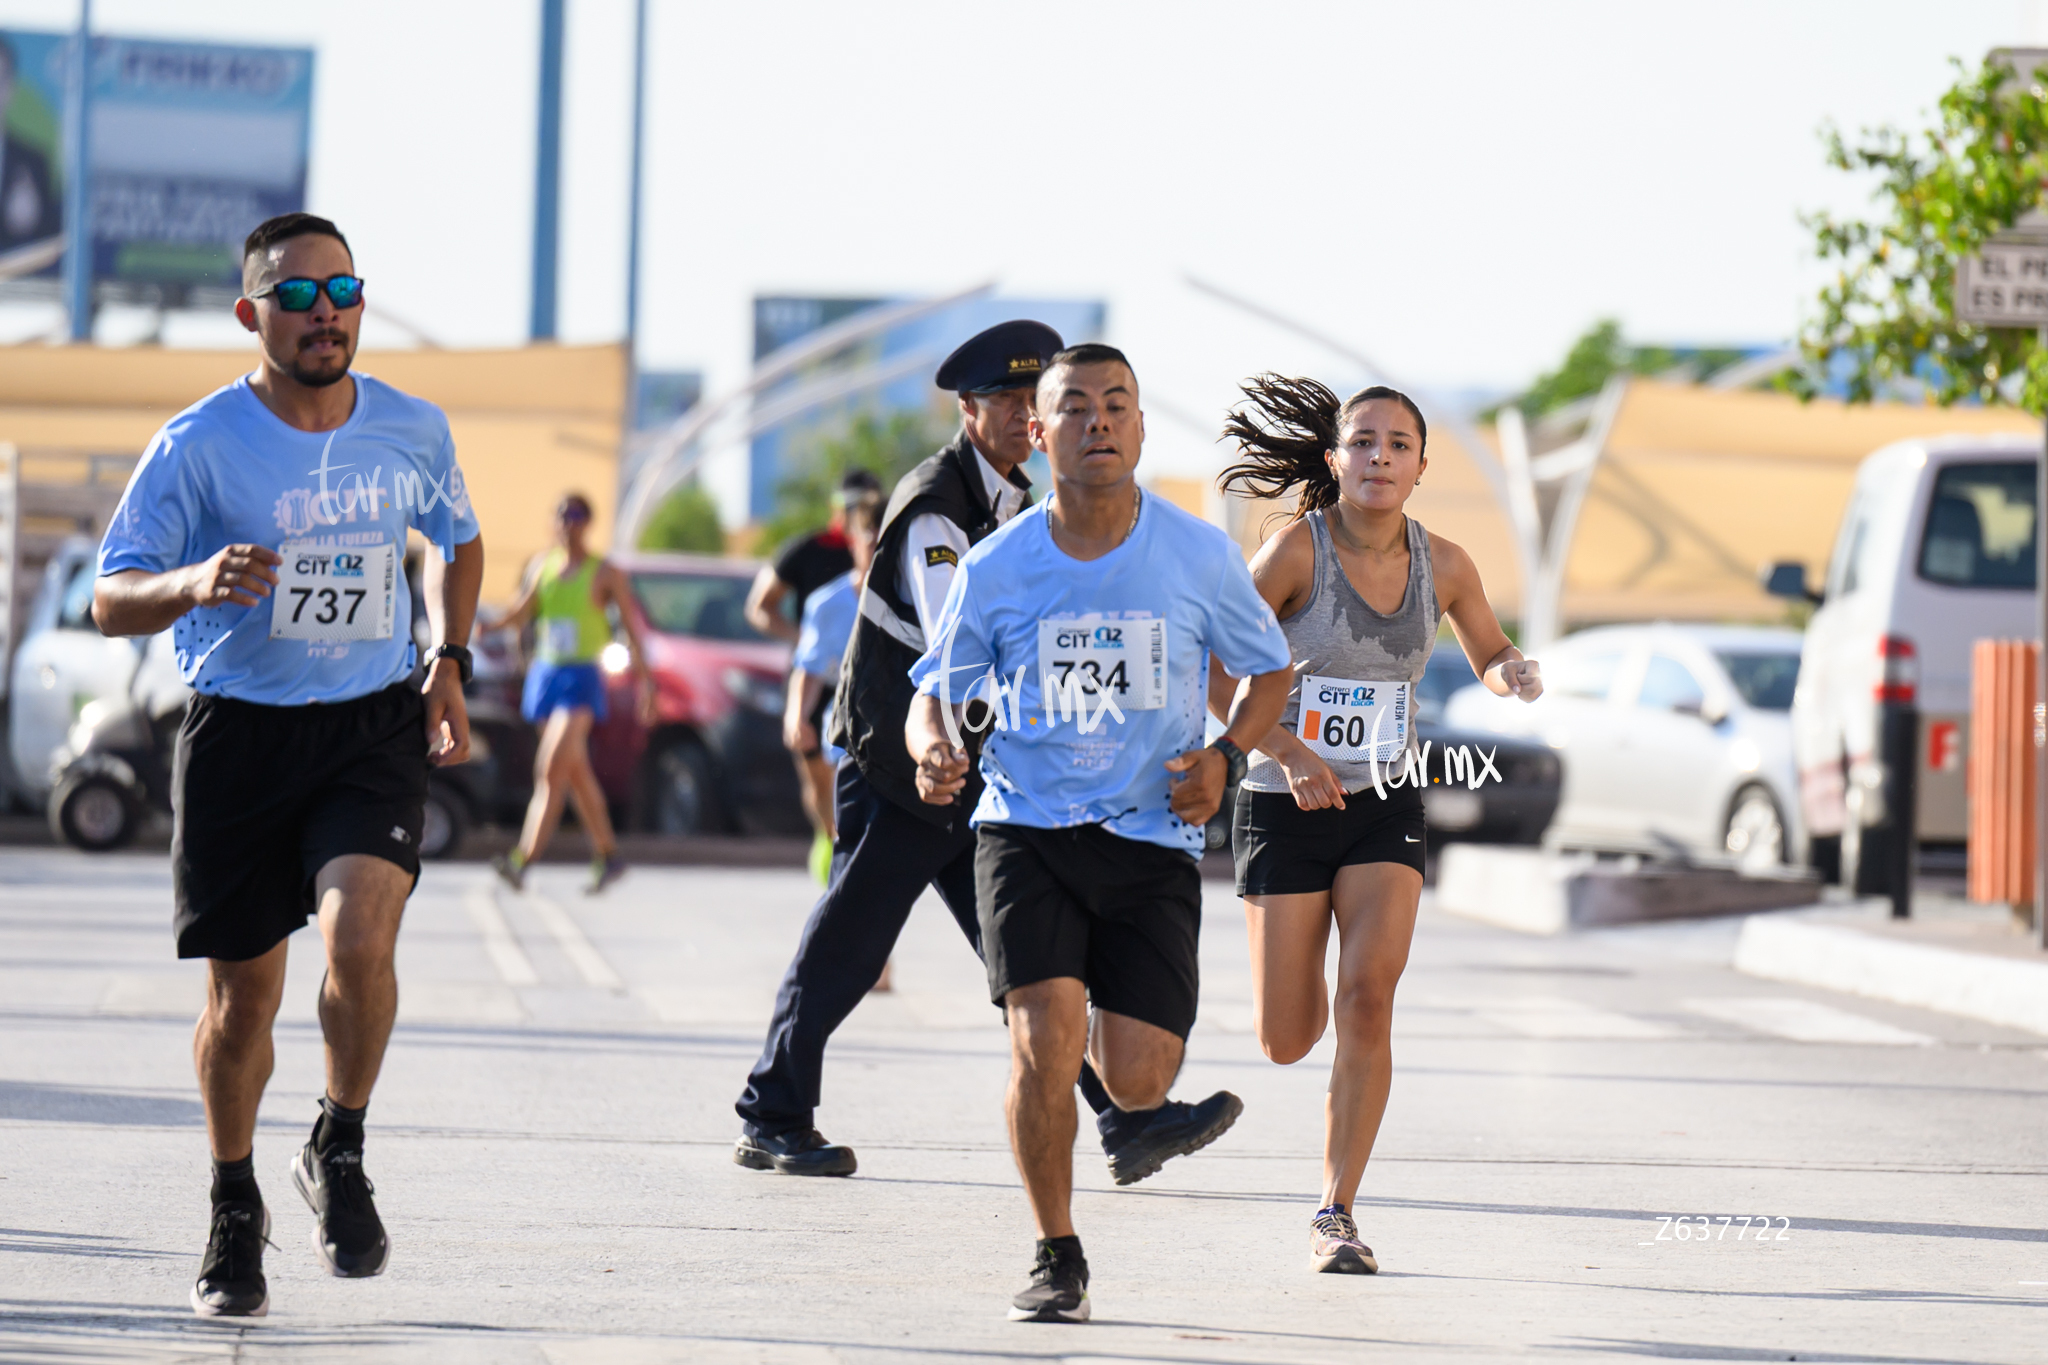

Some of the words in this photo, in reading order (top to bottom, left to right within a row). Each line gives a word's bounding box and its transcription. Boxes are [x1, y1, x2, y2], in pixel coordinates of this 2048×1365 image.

[1981, 256, 2013, 279] EL
[1972, 286, 2004, 309] ES
[1020, 358, 1039, 367] ALFA
[295, 559, 331, 575] CIT
[289, 587, 367, 625] 737
[1056, 633, 1091, 648] CIT
[1053, 659, 1130, 695] 734
[1320, 684, 1350, 693] Carrera
[1318, 690, 1350, 705] CIT
[1394, 686, 1406, 721] MEDALLA
[1323, 714, 1365, 748] 60
